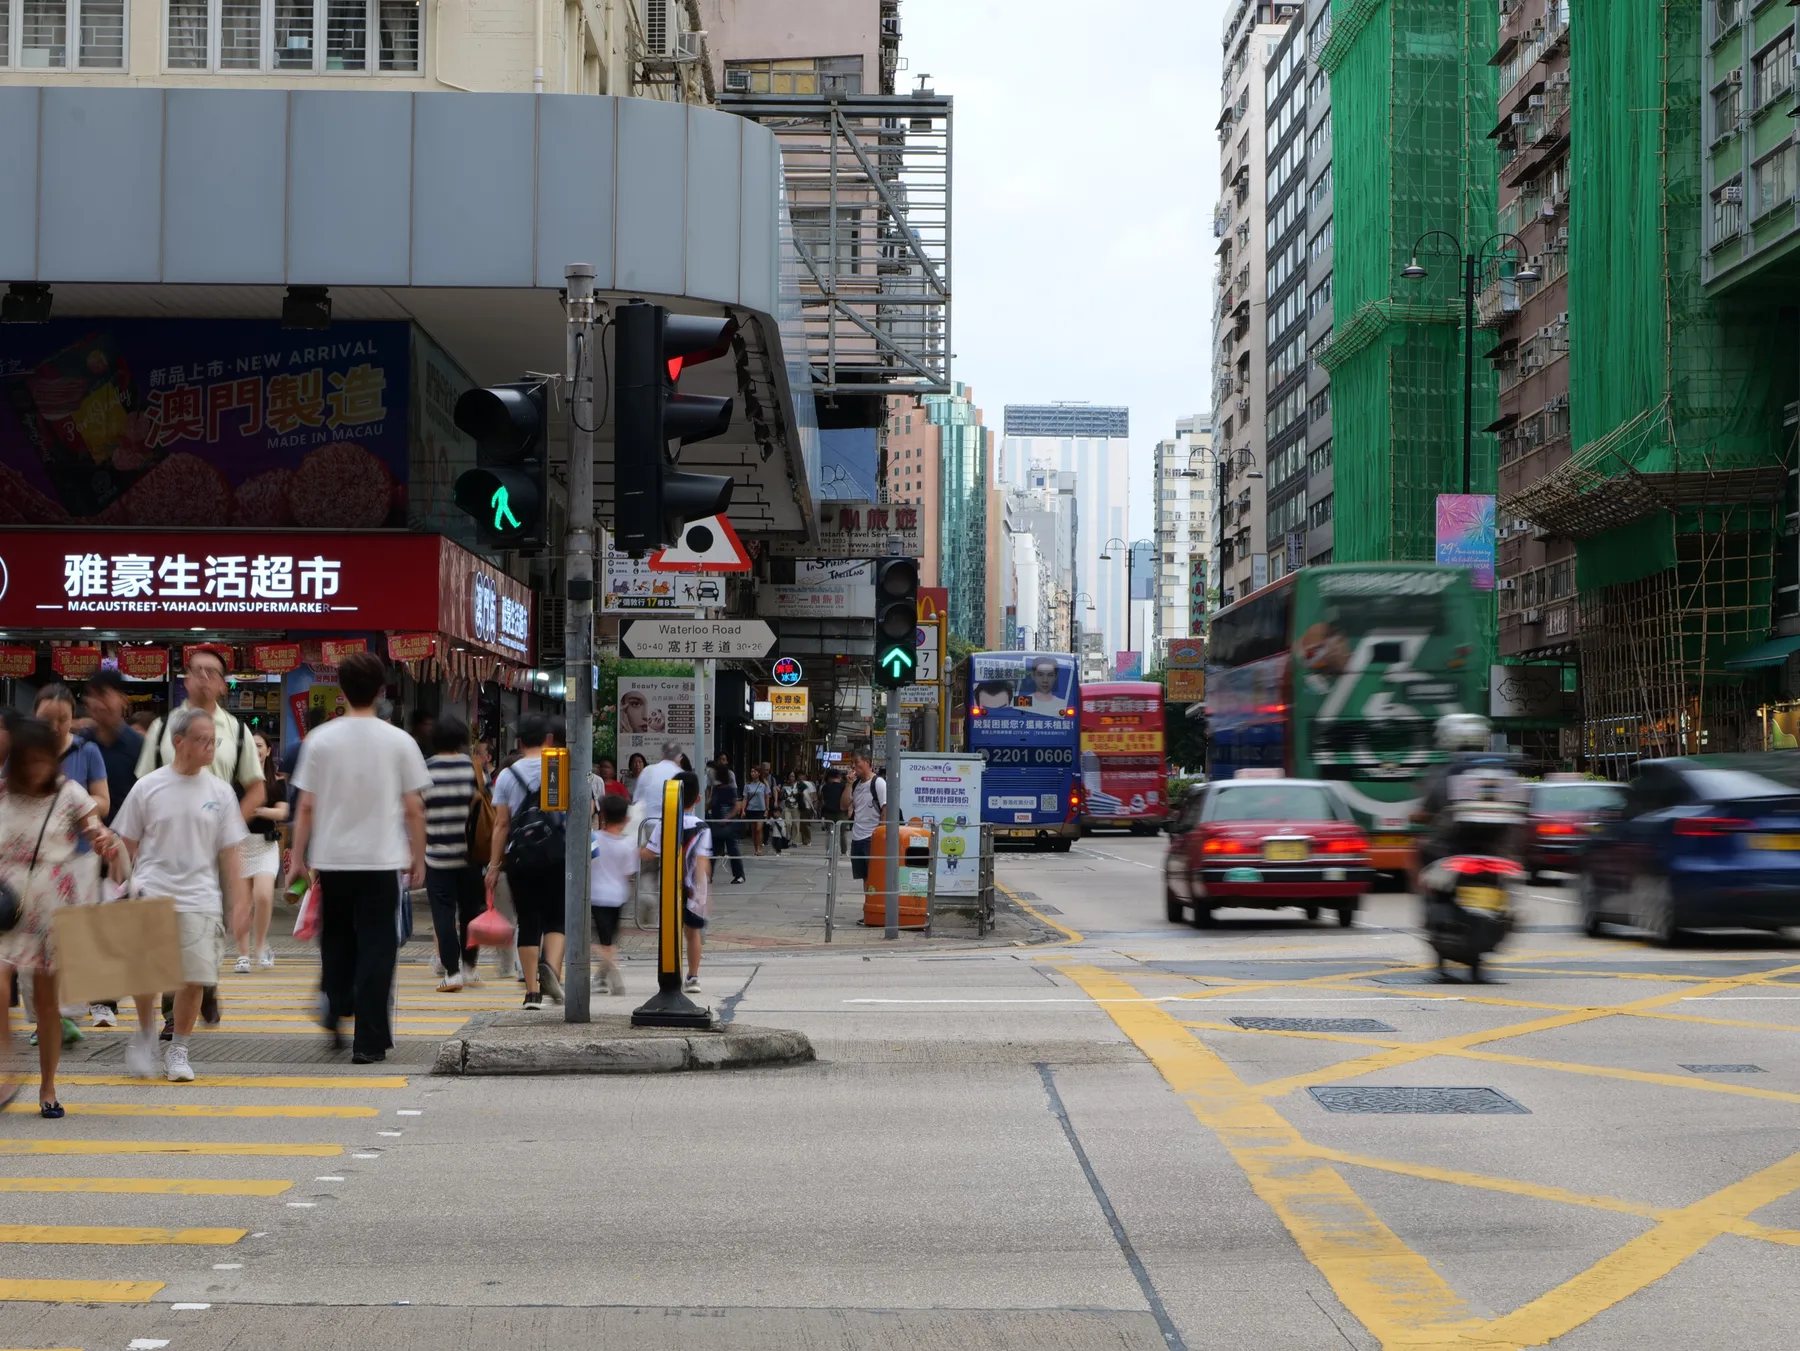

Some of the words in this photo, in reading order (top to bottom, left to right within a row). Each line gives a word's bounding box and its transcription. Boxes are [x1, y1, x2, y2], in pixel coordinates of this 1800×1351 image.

[149, 360, 223, 387] 新品上市
[237, 352, 282, 373] NEW
[289, 339, 378, 366] ARRIVAL
[144, 362, 387, 449] 澳門製造
[267, 434, 307, 449] MADE
[312, 431, 327, 443] IN
[332, 423, 384, 440] MACAU
[63, 552, 342, 600] 雅豪生活超市
[67, 600, 331, 613] MACAUSTREET-YAHAOLIVINSUPERMARKER
[658, 624, 709, 635] Waterloo
[712, 624, 741, 635] Road
[668, 640, 731, 654] 窩打老道
[922, 652, 930, 663] 7
[781, 672, 799, 682] 冰室
[922, 667, 930, 679] 7
[631, 682, 658, 690] Beauty
[775, 694, 801, 704] 吉野家
[992, 748, 1029, 763] 2201
[1035, 748, 1073, 763] 0606
